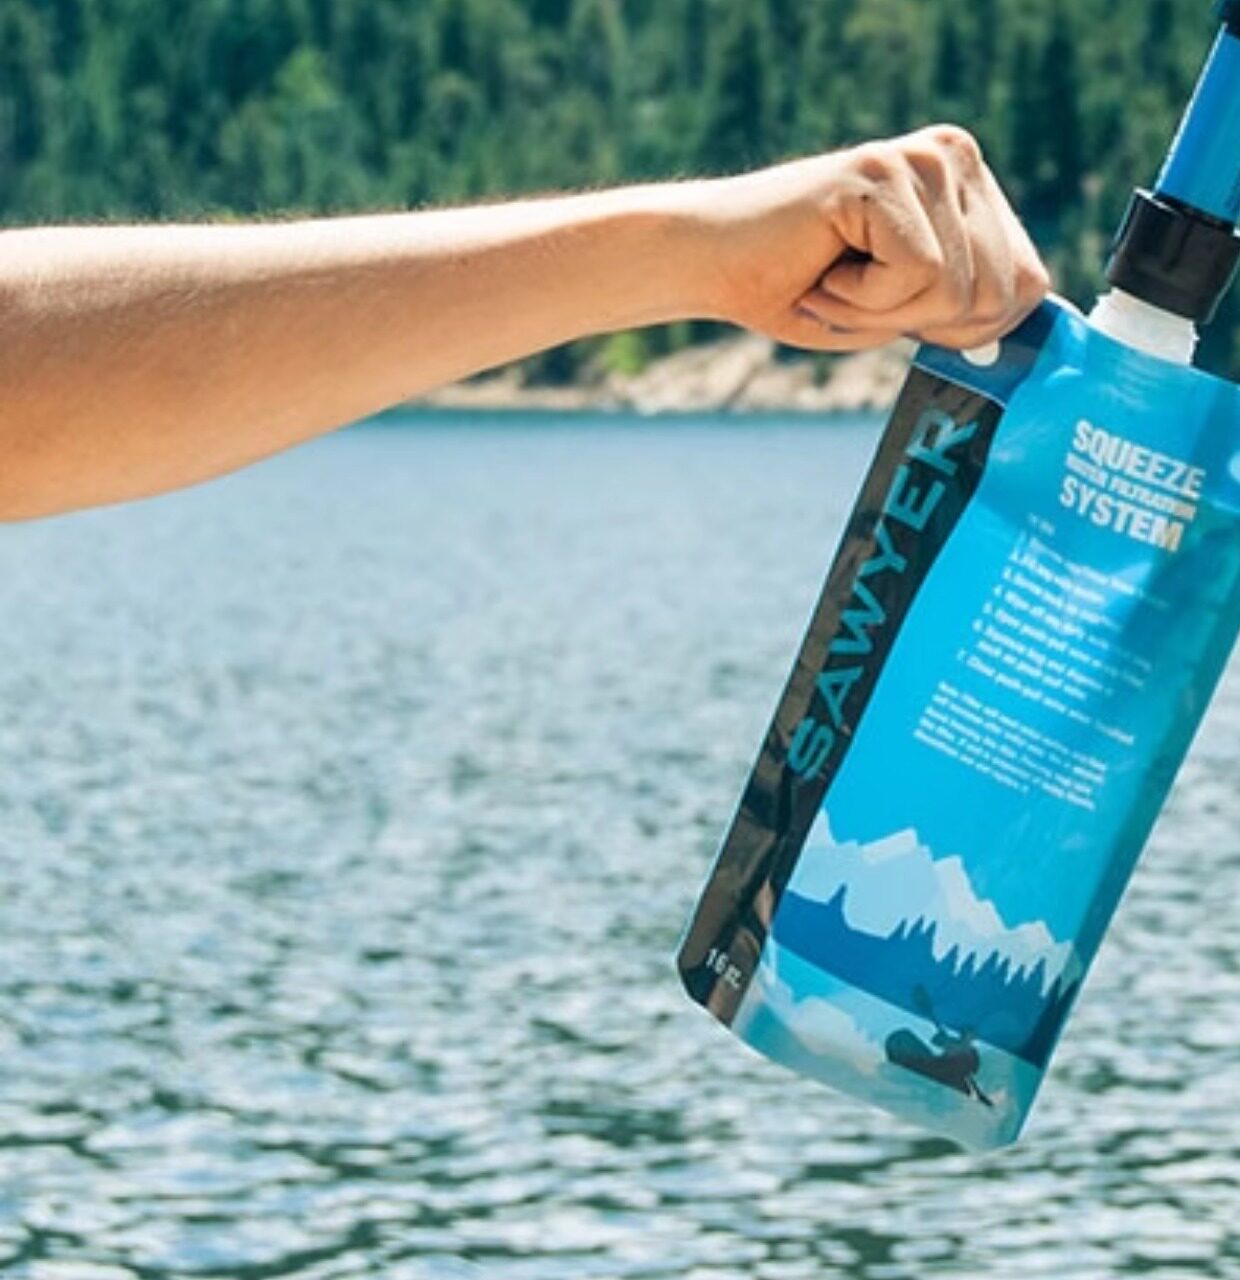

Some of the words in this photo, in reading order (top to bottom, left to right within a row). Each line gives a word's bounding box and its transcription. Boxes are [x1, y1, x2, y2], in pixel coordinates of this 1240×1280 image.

[1072, 418, 1207, 501] SQUEEZE
[1059, 474, 1185, 553] SYSTEM
[787, 404, 979, 782] SAWYER
